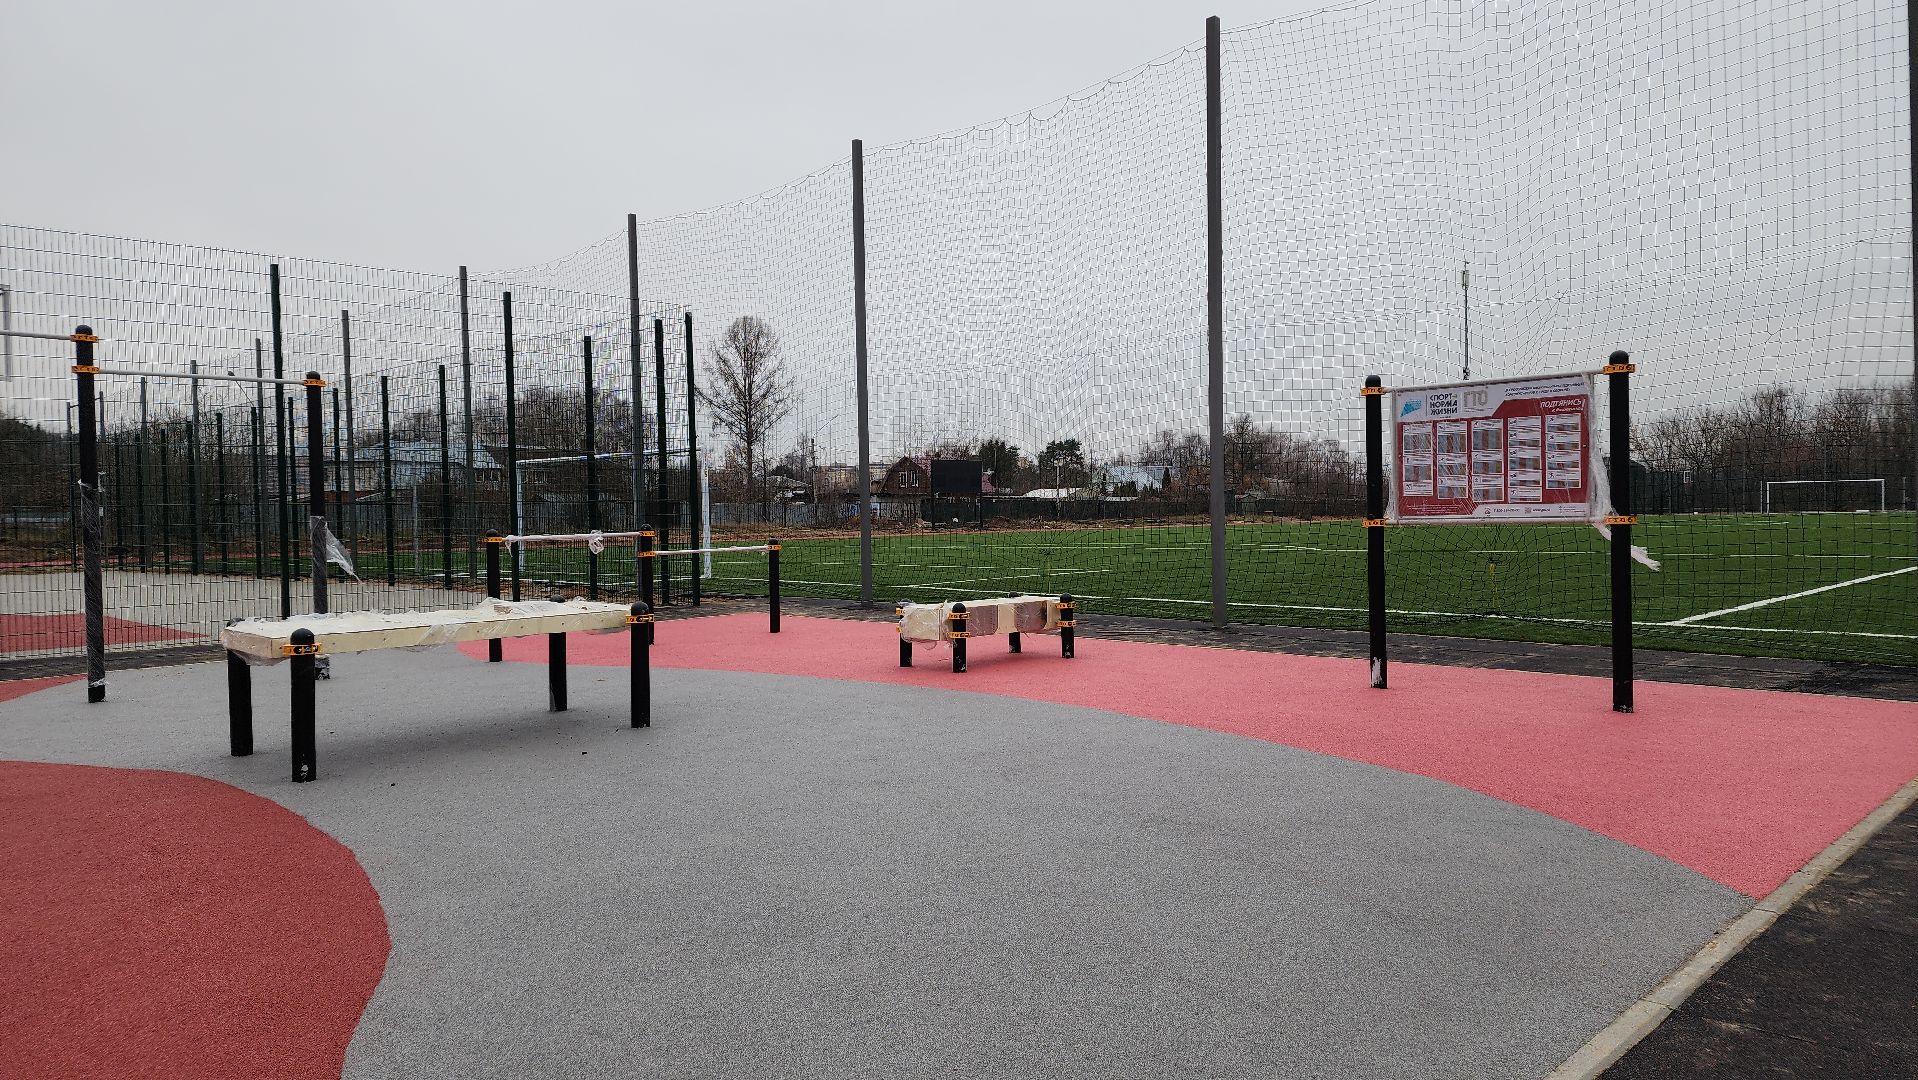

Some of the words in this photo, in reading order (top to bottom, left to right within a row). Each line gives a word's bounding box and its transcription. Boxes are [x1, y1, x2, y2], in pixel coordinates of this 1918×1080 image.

[1463, 389, 1489, 408] ГТО
[1430, 400, 1458, 409] НОРМА
[1430, 408, 1458, 416] ЖИЗНИ
